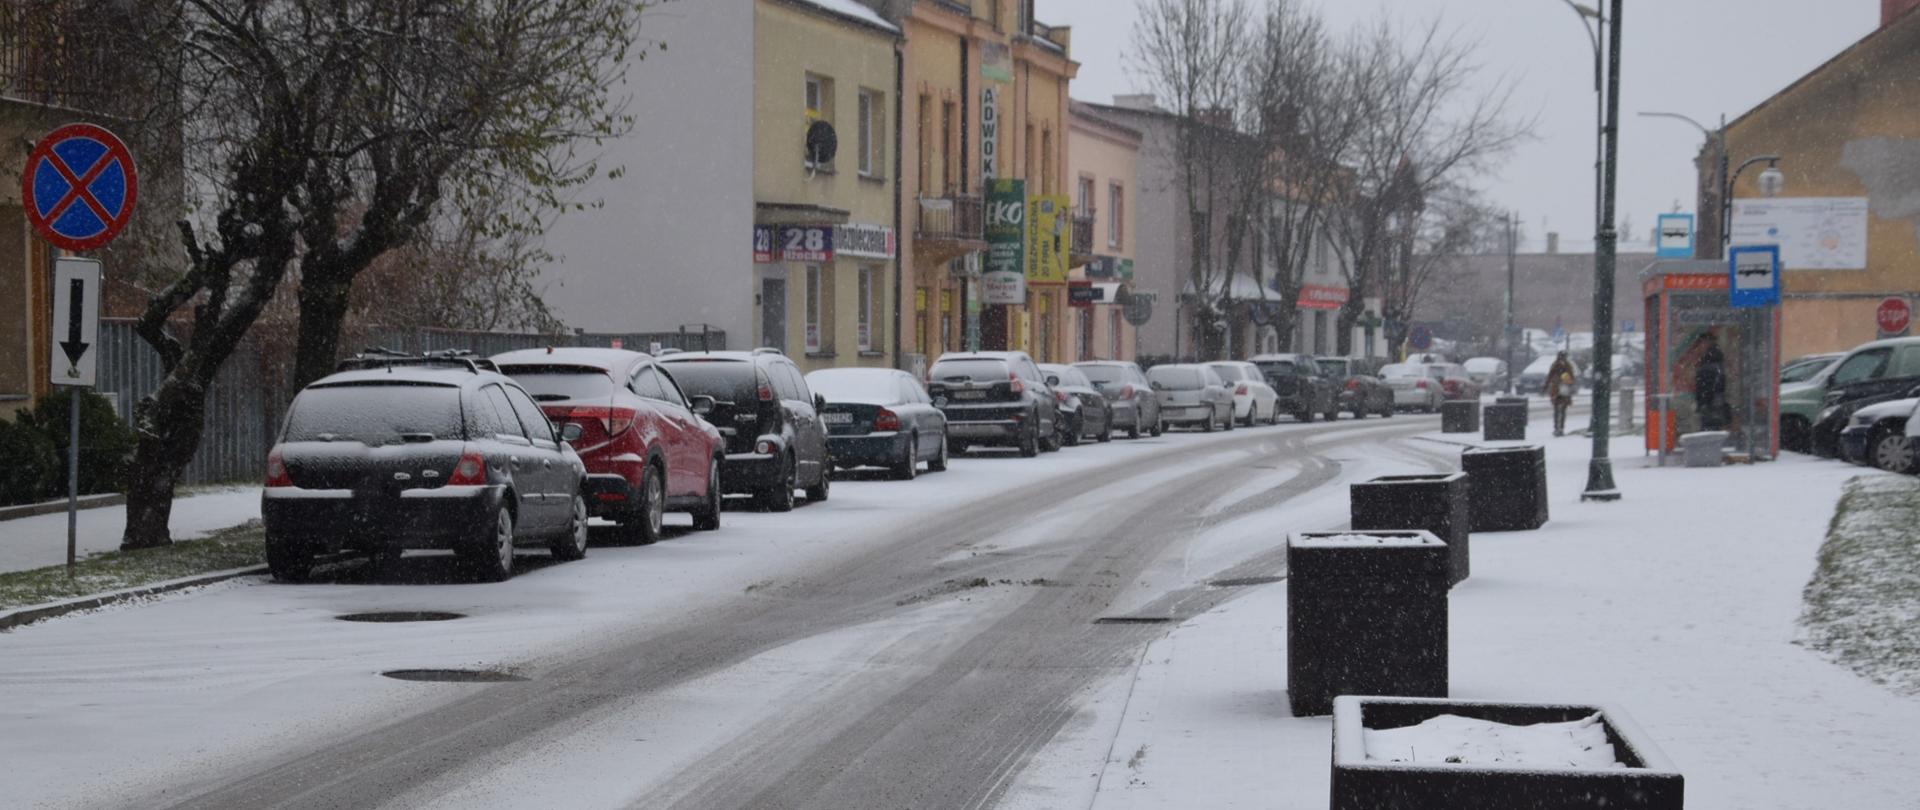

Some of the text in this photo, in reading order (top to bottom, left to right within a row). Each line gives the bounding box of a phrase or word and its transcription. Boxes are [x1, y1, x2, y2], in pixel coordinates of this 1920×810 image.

[983, 88, 995, 180] ADWOK
[985, 200, 1022, 225] EKO
[755, 228, 770, 251] 28
[785, 228, 825, 251] 28
